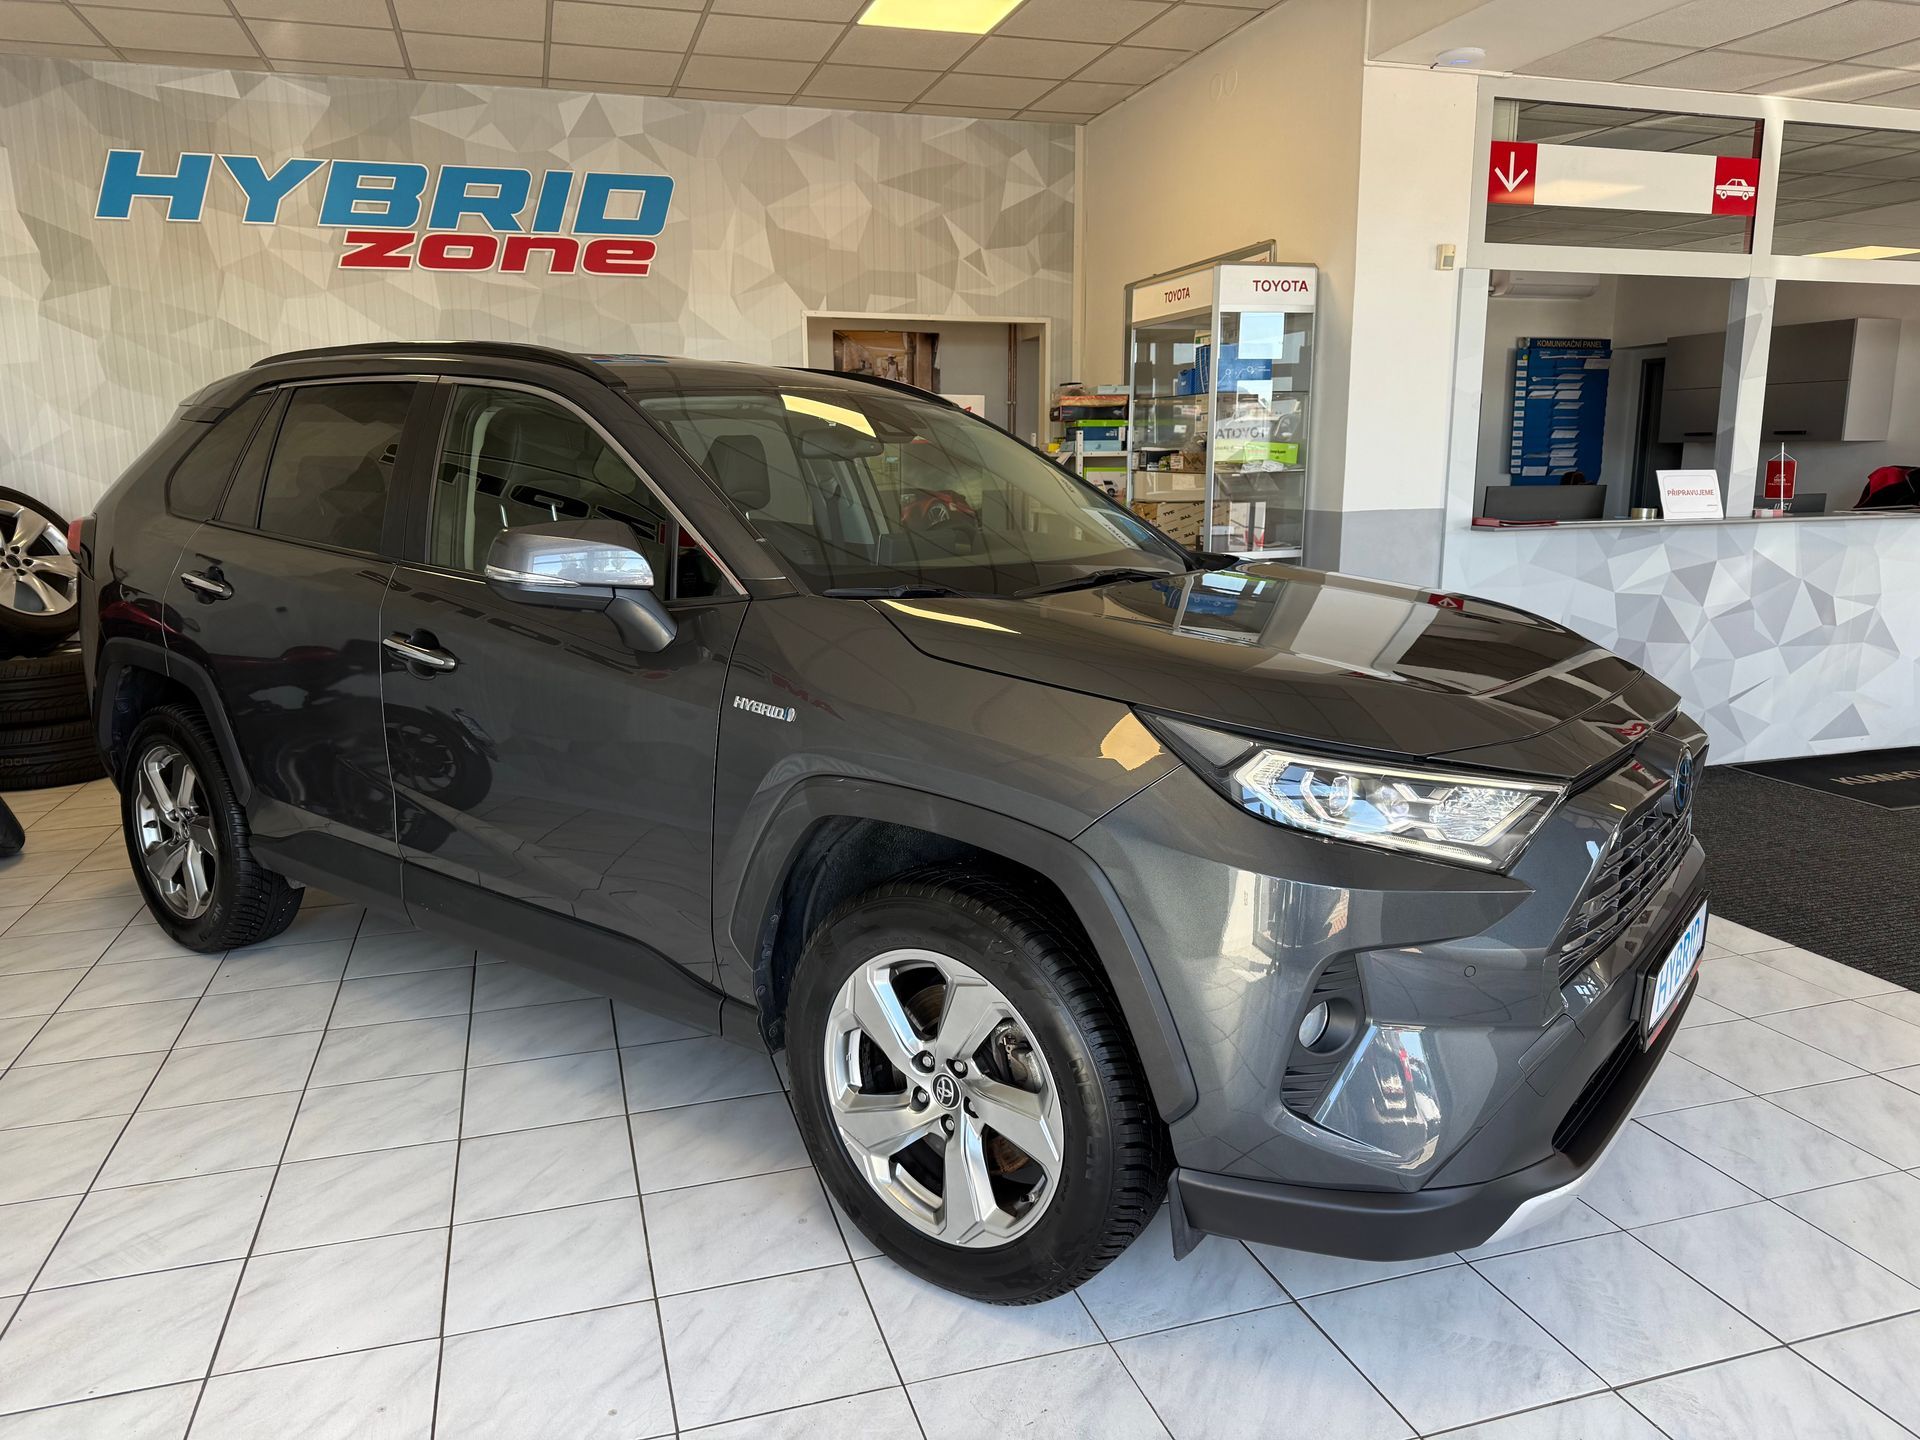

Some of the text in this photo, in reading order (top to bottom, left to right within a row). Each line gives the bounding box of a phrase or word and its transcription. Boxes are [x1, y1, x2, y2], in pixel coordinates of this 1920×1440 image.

[94, 149, 676, 238] HYBRID
[338, 229, 657, 277] zone
[1164, 287, 1191, 303] TOYOTA
[1252, 280, 1309, 292] TOYOTA
[1536, 339, 1602, 349] KOMUNIKAČNÍ PANEL
[1667, 488, 1715, 496] PŘIPRAVUJEME
[733, 695, 785, 720] HYBRID
[1655, 916, 1700, 1013] HYBRID
